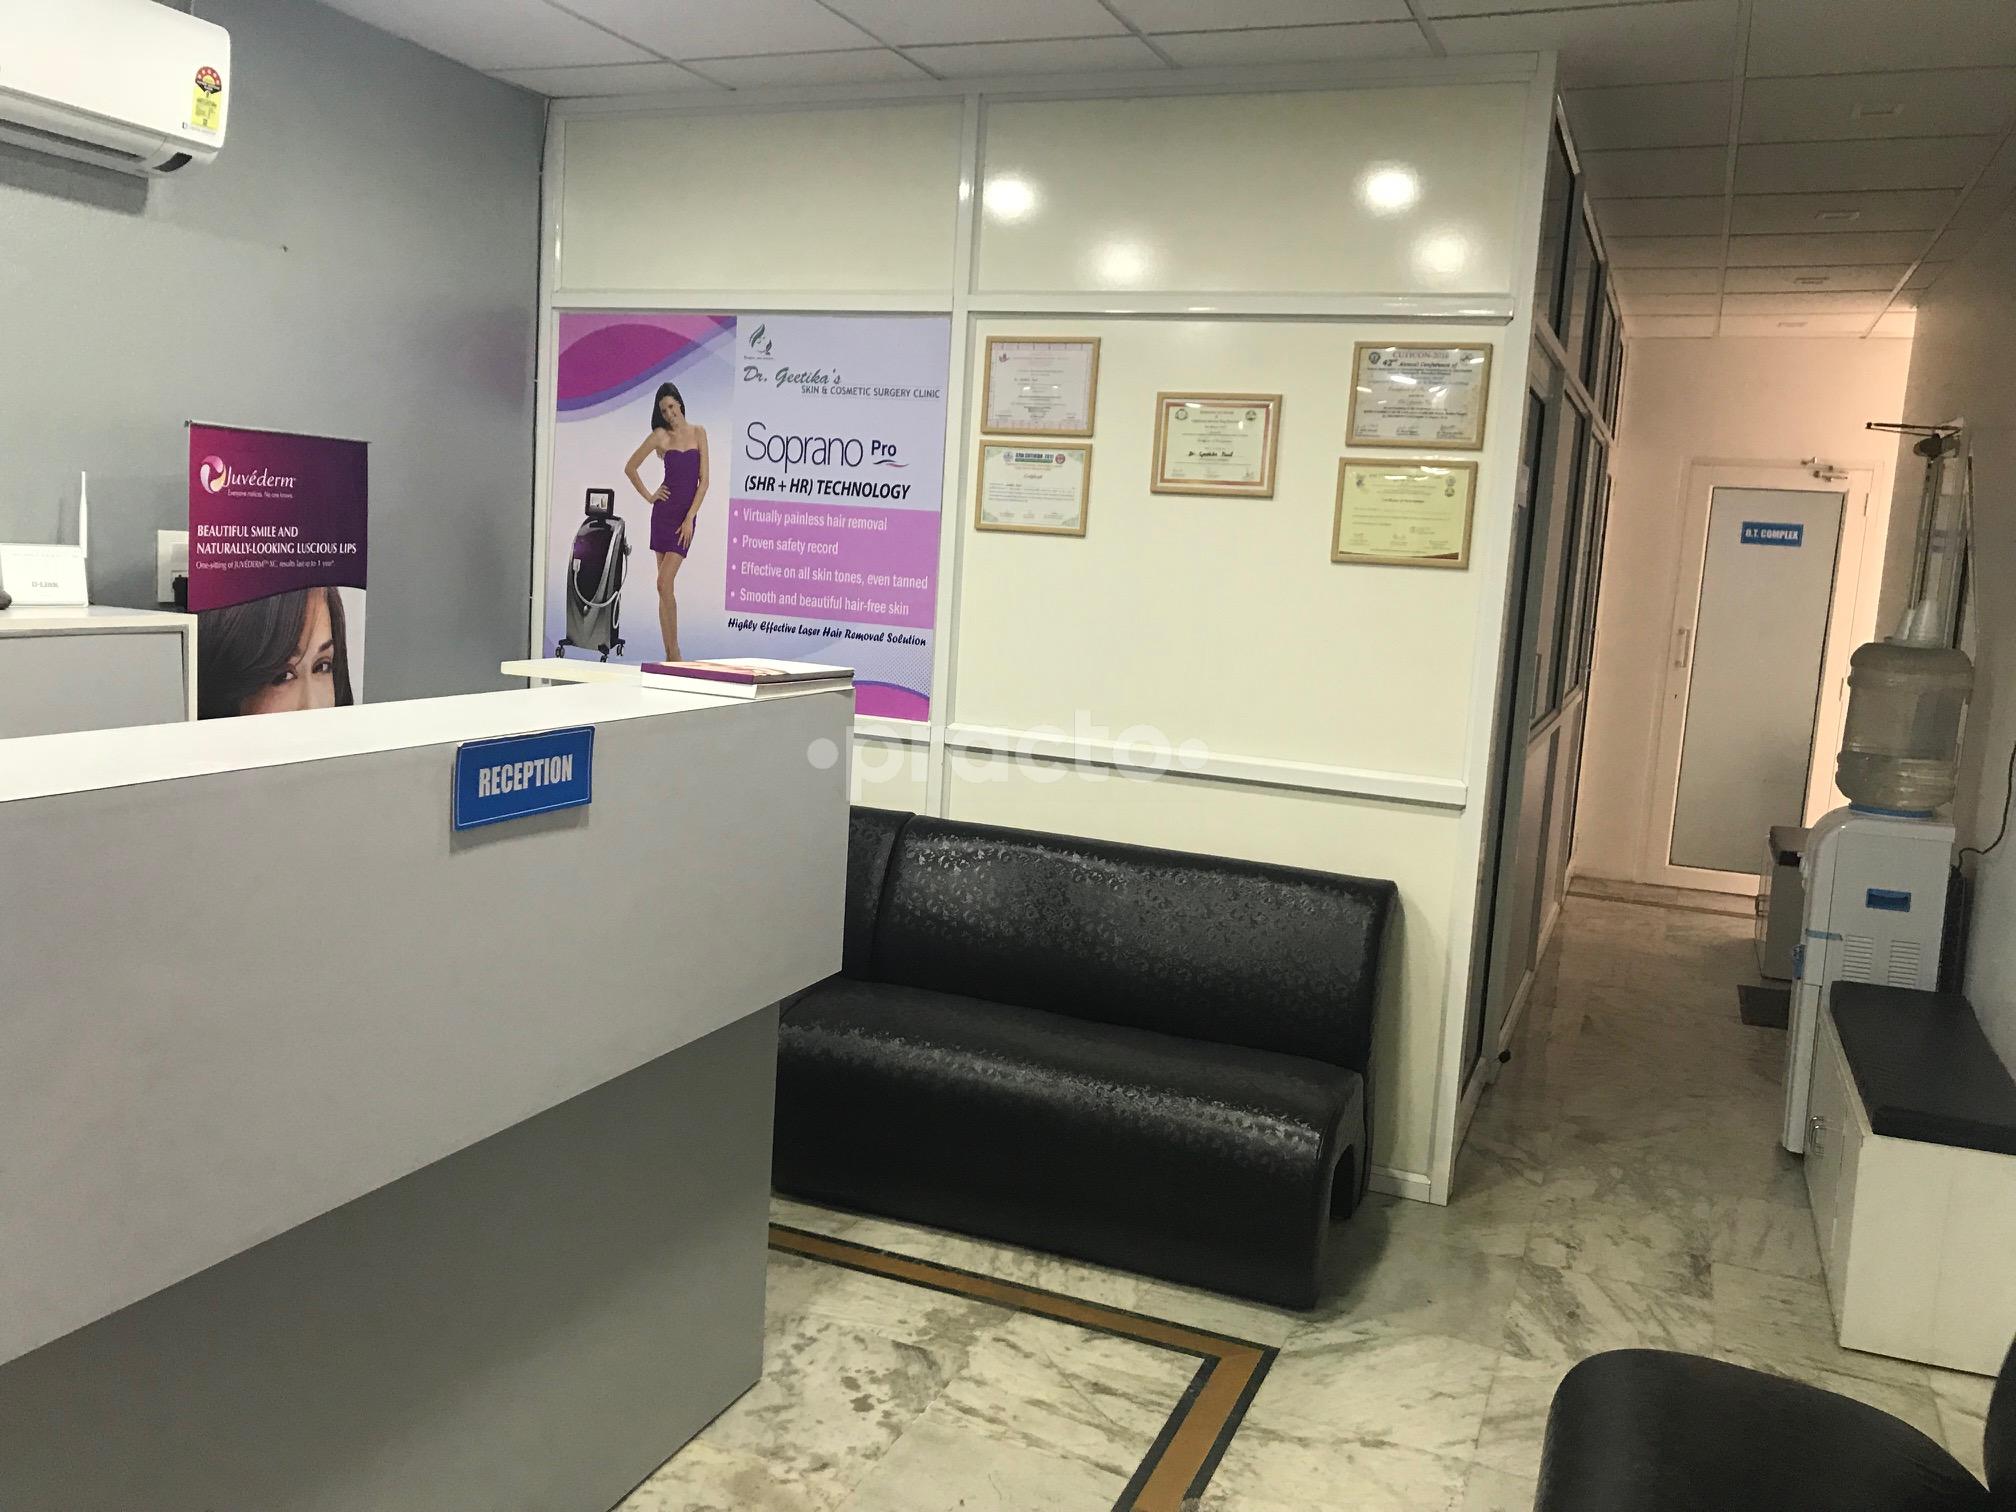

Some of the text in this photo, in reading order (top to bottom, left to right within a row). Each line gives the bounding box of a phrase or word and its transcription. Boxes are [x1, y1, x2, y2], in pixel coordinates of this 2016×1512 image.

[744, 366, 841, 388] Dr. Geetika's
[801, 385, 940, 398] SKIN & COSMETIC SURGERY CLINIC
[746, 422, 897, 473] Soprano Pro
[223, 466, 294, 488] Juvéderm
[744, 475, 911, 499] (SHR + HR) TECHNOLOGY
[743, 508, 888, 531] Virtually painless hair removal
[197, 525, 299, 538] BEAUTIFUL SMILE AND
[1761, 529, 1798, 540] COMPLEX
[196, 542, 357, 554] NATURALLY-LOOKING LUSCIOUS LIPS
[742, 535, 838, 555] Proven safety record
[741, 561, 928, 589] Effective on all skin tones, even tanned
[740, 588, 909, 615] Smooth and beautiful hair-free skin
[728, 618, 926, 646] Highly Effective Laser Hair Removal Solution
[478, 753, 574, 798] RECEPTION
